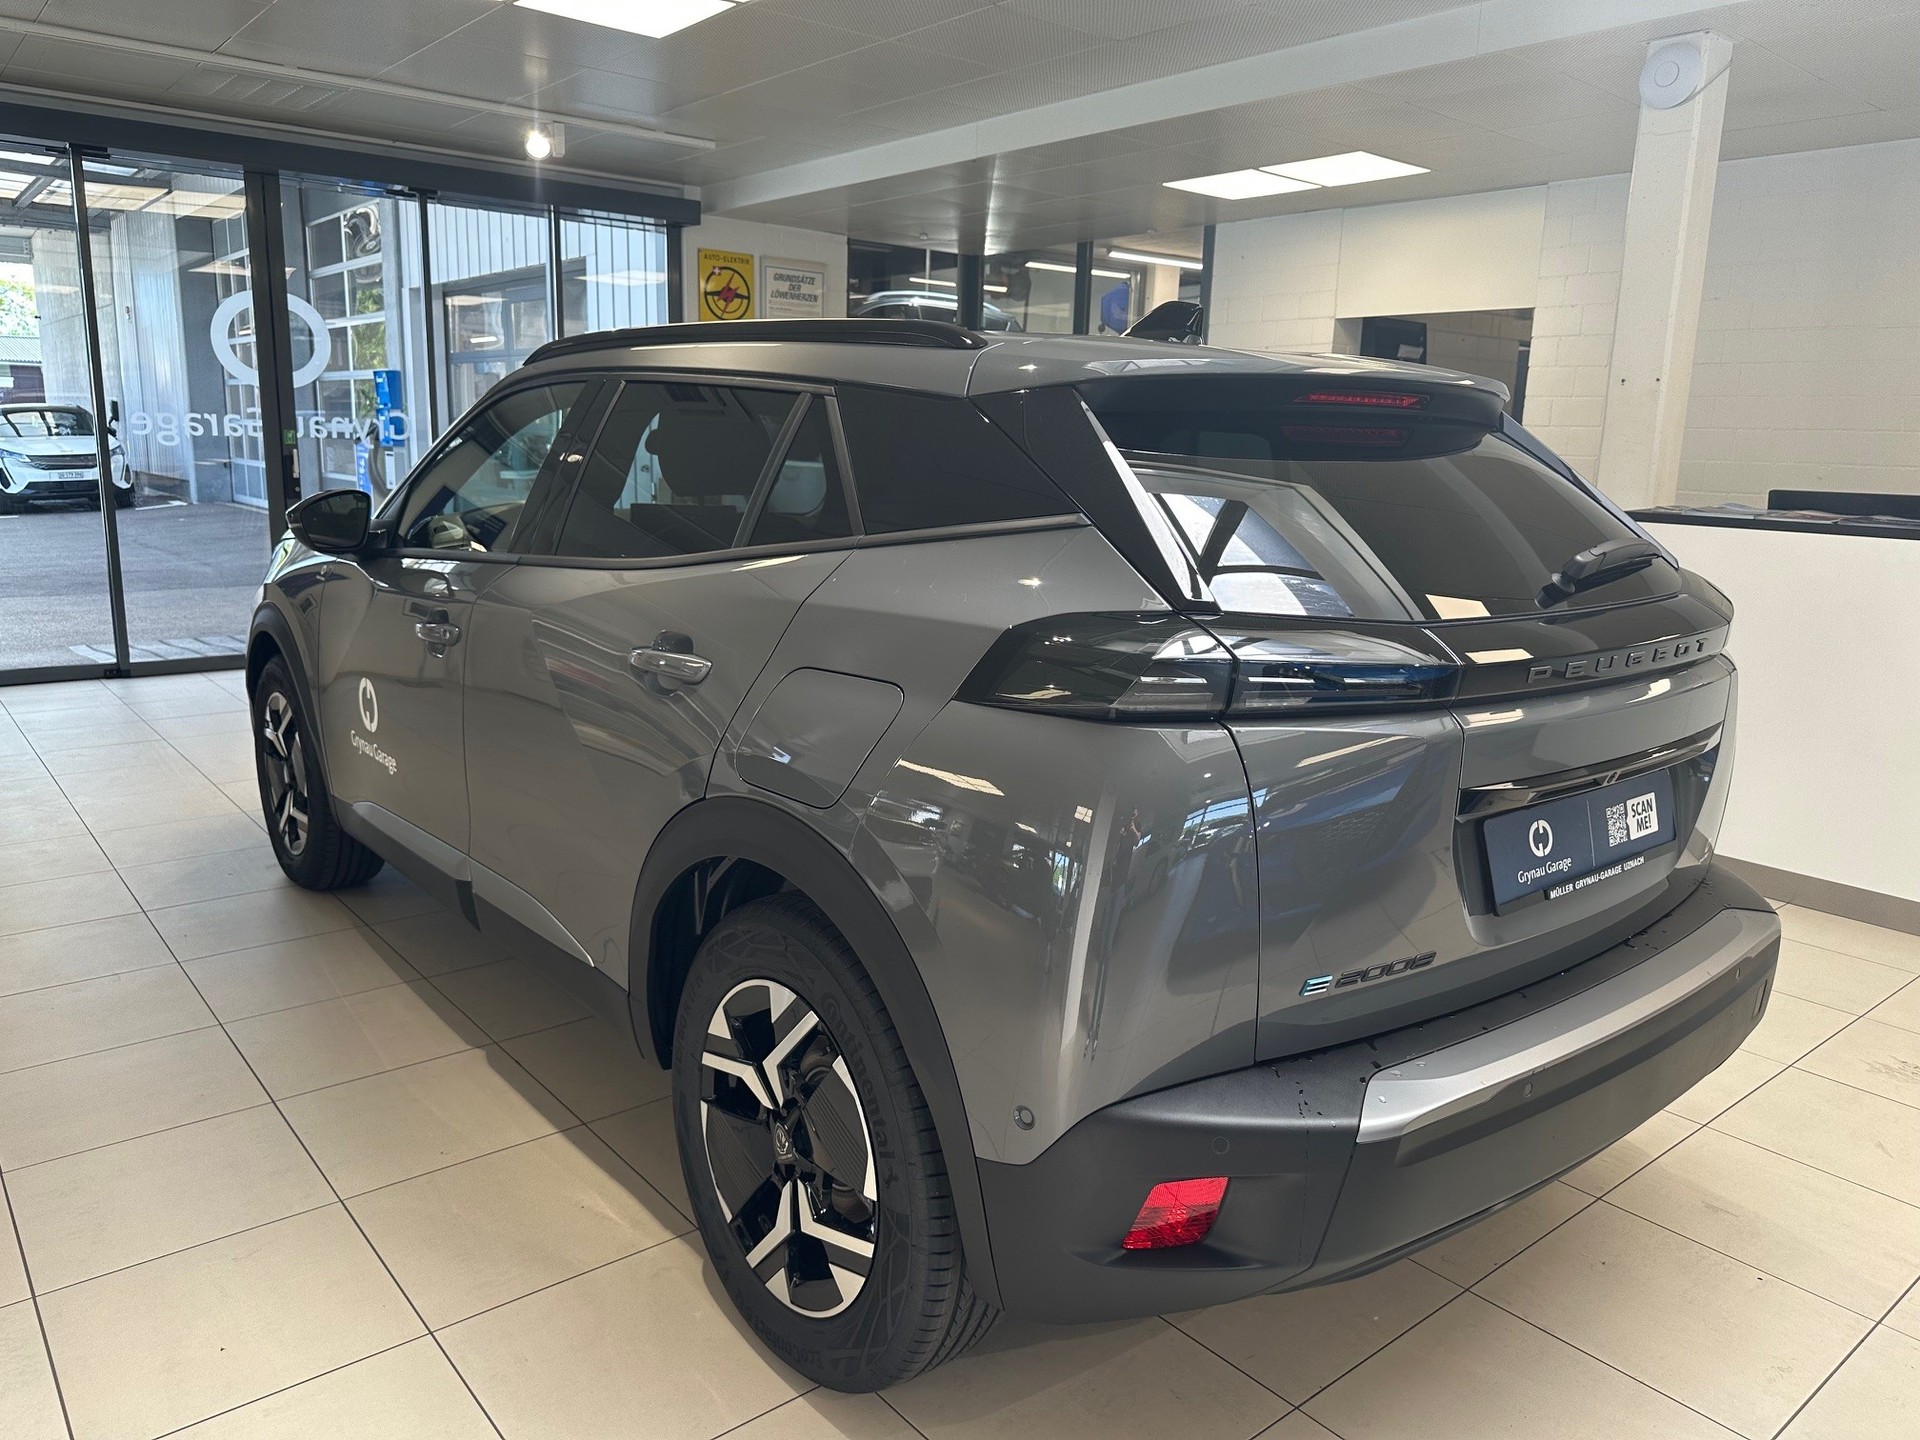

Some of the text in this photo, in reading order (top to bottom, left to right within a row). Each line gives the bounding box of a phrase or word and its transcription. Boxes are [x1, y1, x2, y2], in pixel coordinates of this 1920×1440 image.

[703, 253, 750, 265] AUTO-ELEKTRIK
[773, 272, 816, 286] GRUNDSÄTZE
[788, 283, 802, 292] DER
[770, 289, 819, 303] LÖWENHERZEN
[1526, 637, 1710, 684] PEUGEOT
[350, 729, 398, 775] Grynau Garage
[1631, 797, 1653, 818] SCAN
[1636, 813, 1652, 834] ME!
[1517, 856, 1572, 885] Grynau Garage
[1550, 855, 1645, 900] MÜLLER GRYNAU-GARAGE UZNACH
[1334, 950, 1438, 989] 2008
[820, 990, 897, 1160] Continental
